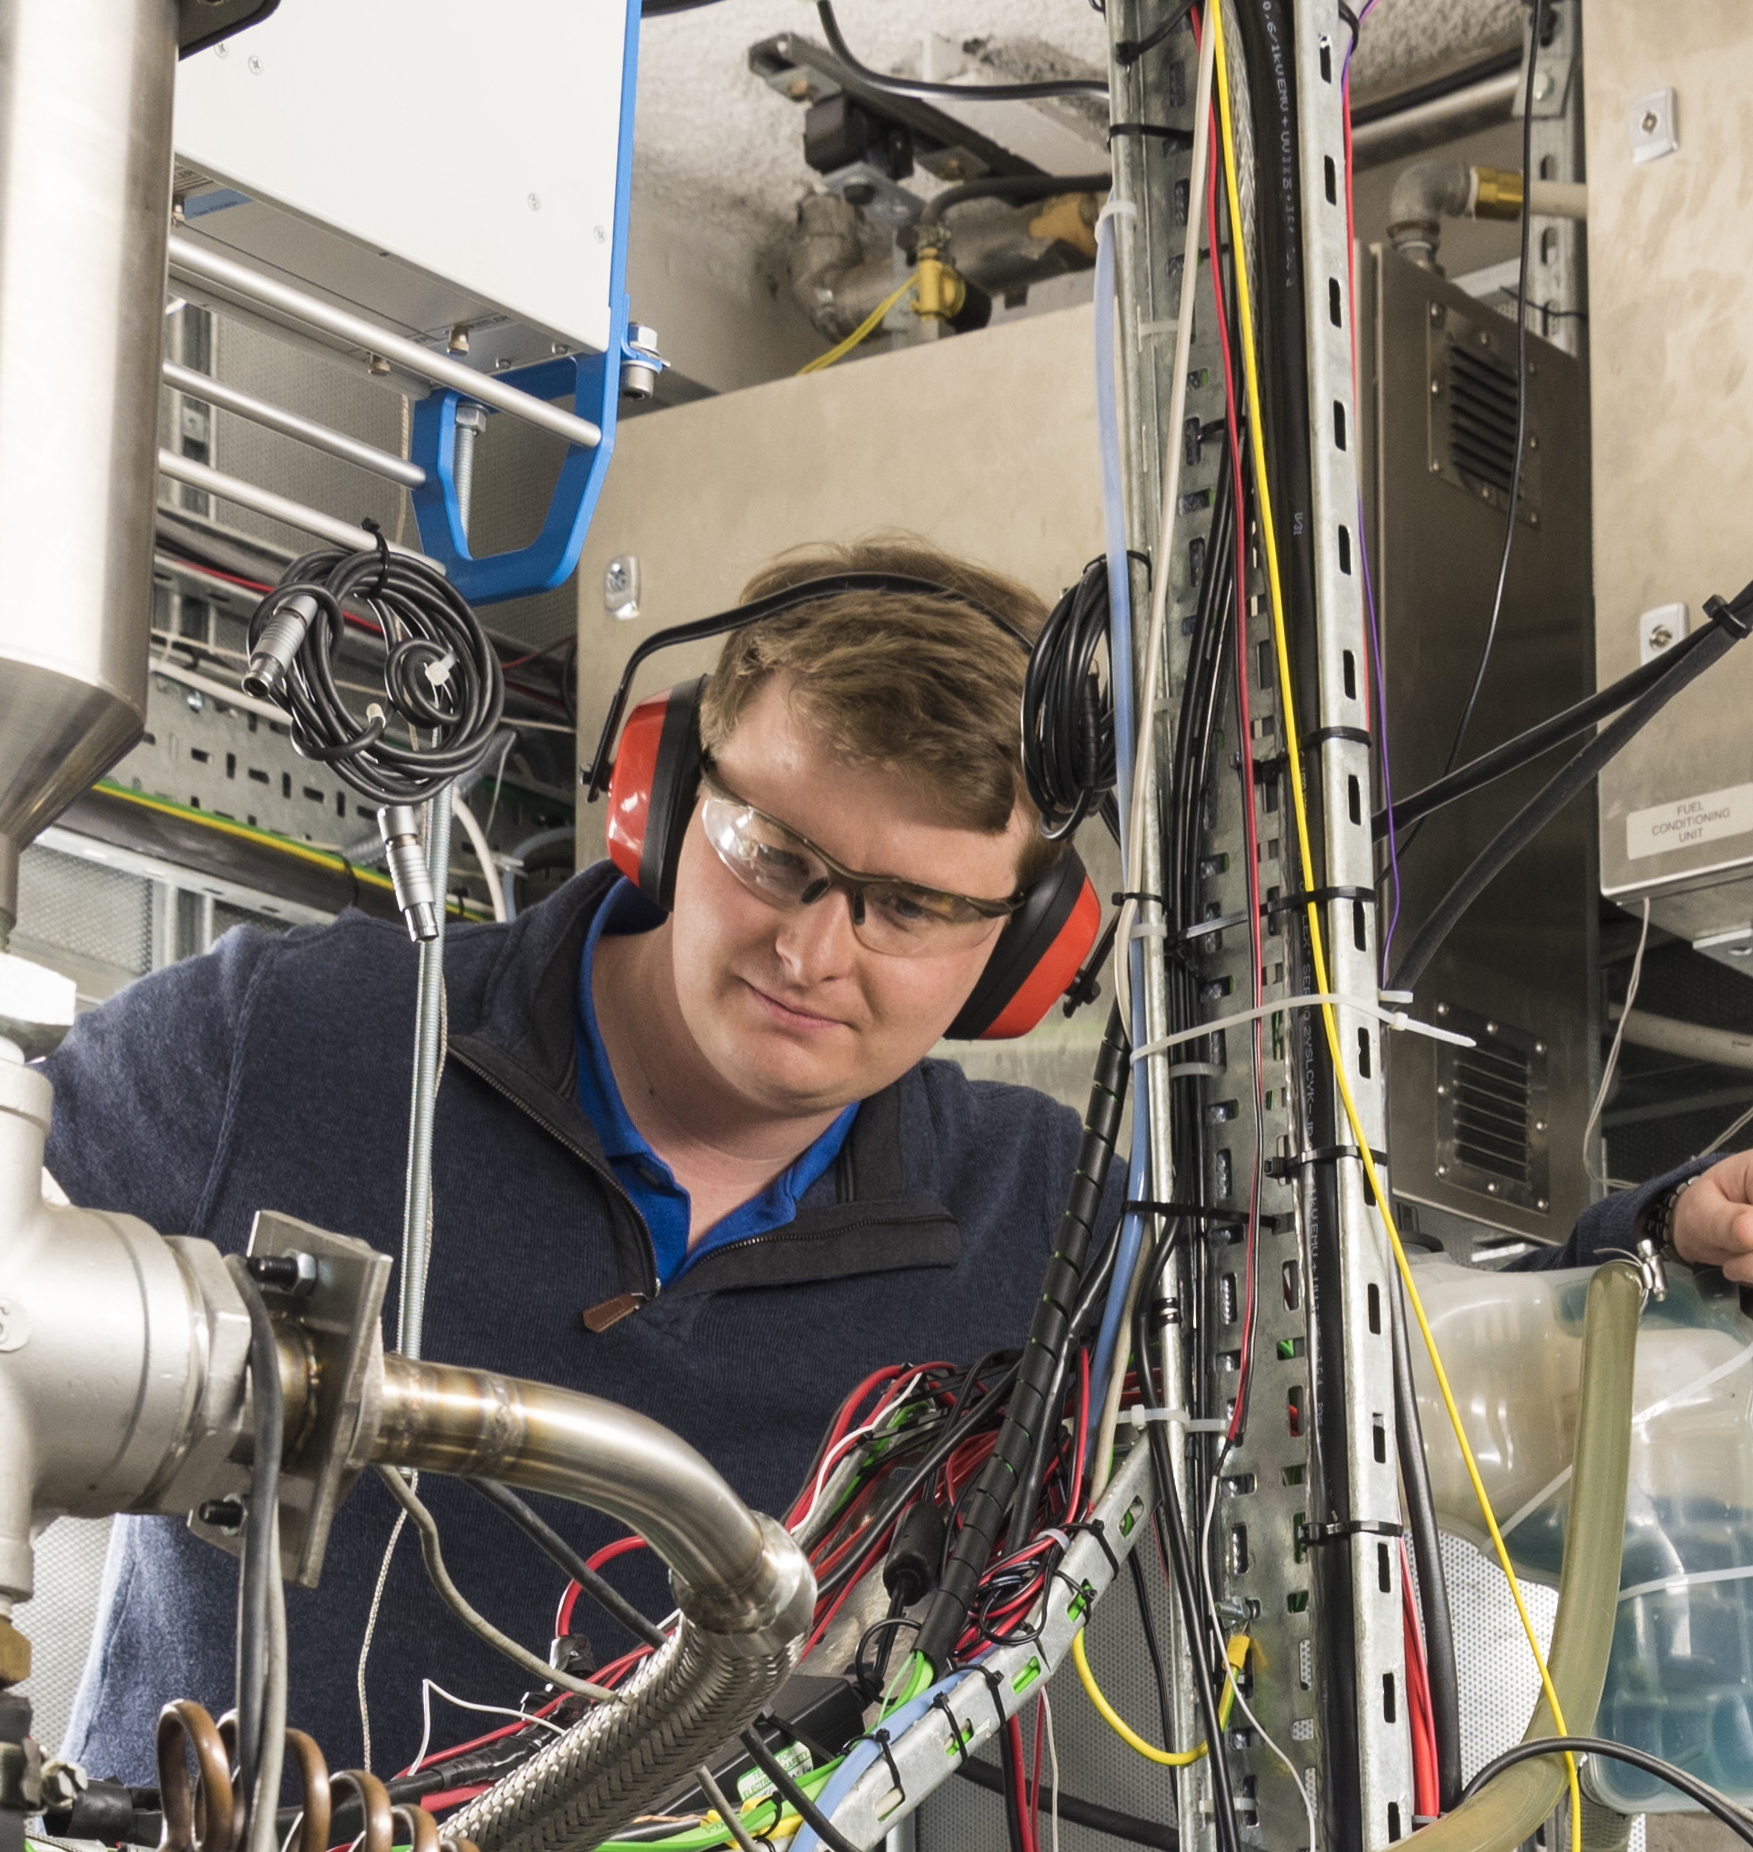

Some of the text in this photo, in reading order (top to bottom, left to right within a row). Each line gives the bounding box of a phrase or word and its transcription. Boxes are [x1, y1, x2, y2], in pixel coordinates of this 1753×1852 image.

[1677, 801, 1704, 816] FUEL
[1652, 807, 1730, 836] CONDITIONING
[1678, 828, 1704, 843] UNIT
